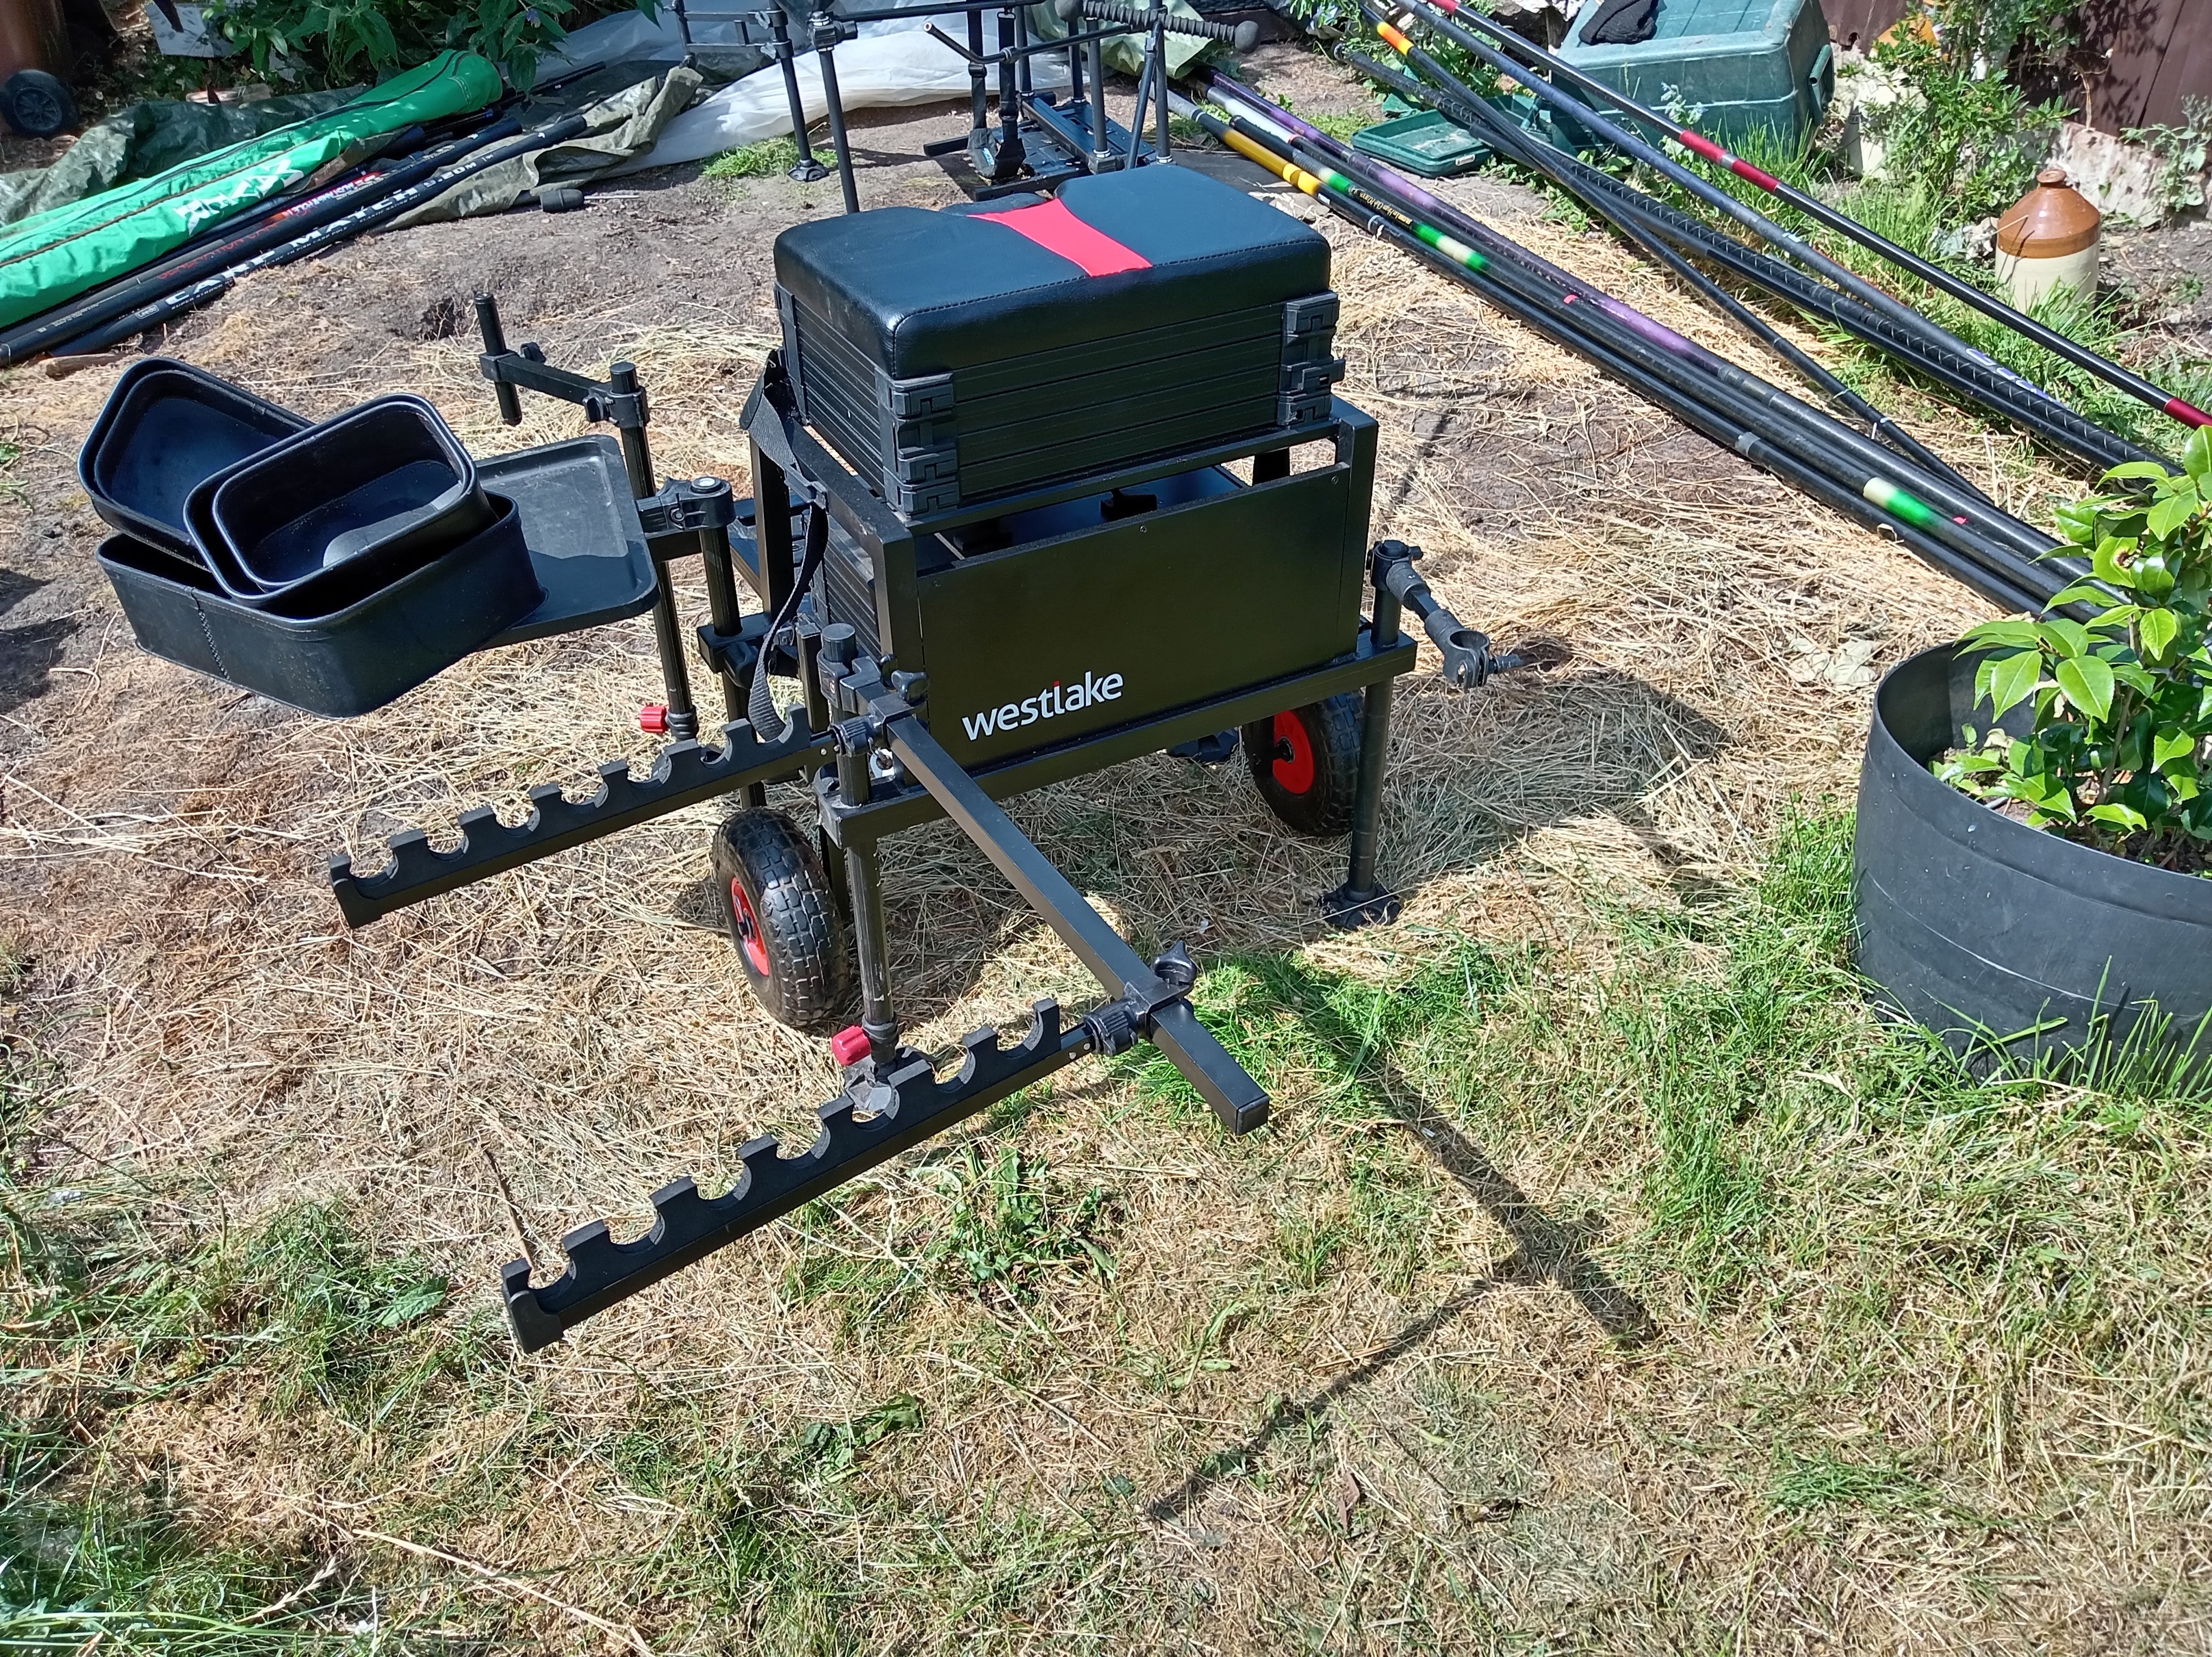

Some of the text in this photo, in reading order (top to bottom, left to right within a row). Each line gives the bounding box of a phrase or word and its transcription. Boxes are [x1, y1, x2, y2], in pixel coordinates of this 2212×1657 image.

[165, 250, 275, 306] CARP
[290, 187, 417, 247] MATCH
[962, 671, 1124, 741] westlake
